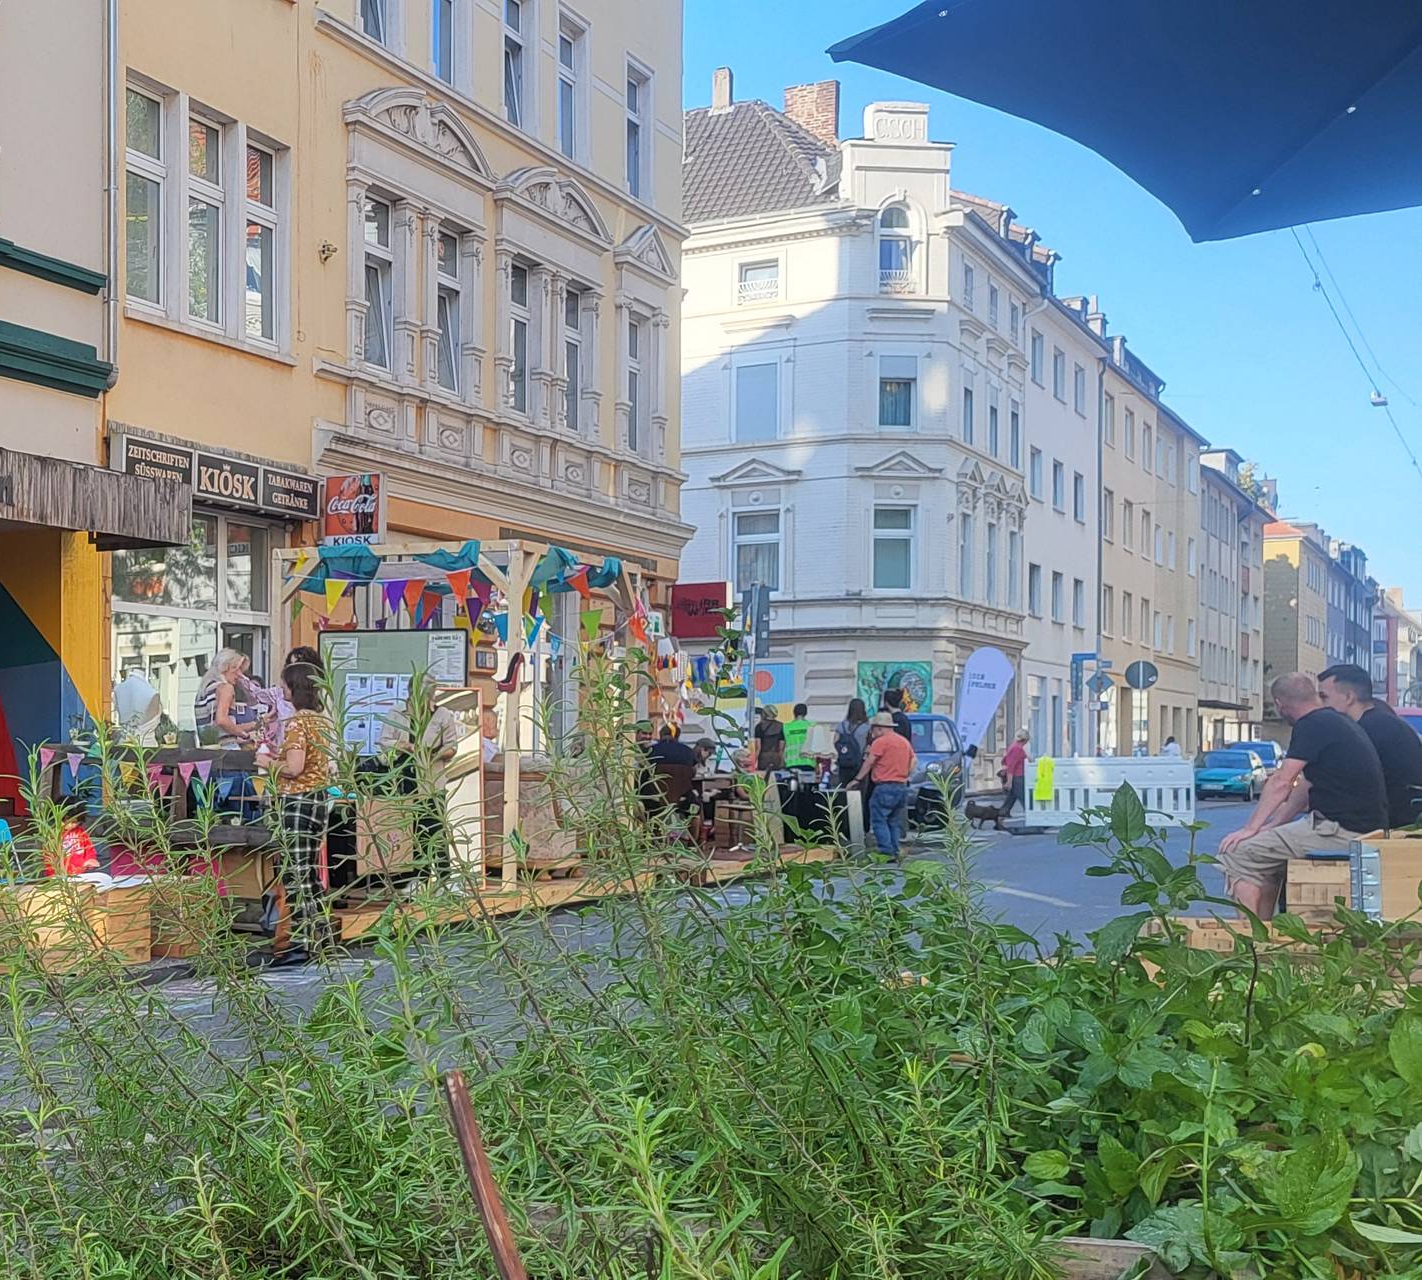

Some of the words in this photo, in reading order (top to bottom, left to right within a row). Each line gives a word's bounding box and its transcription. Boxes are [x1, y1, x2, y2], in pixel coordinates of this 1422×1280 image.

[127, 445, 190, 470] ZEITSCHRIFTEN
[199, 466, 256, 501] KIOSK
[267, 473, 313, 494] TABAKWAREN
[272, 492, 308, 510] GETRÄNKE
[333, 535, 371, 546] KIOSK
